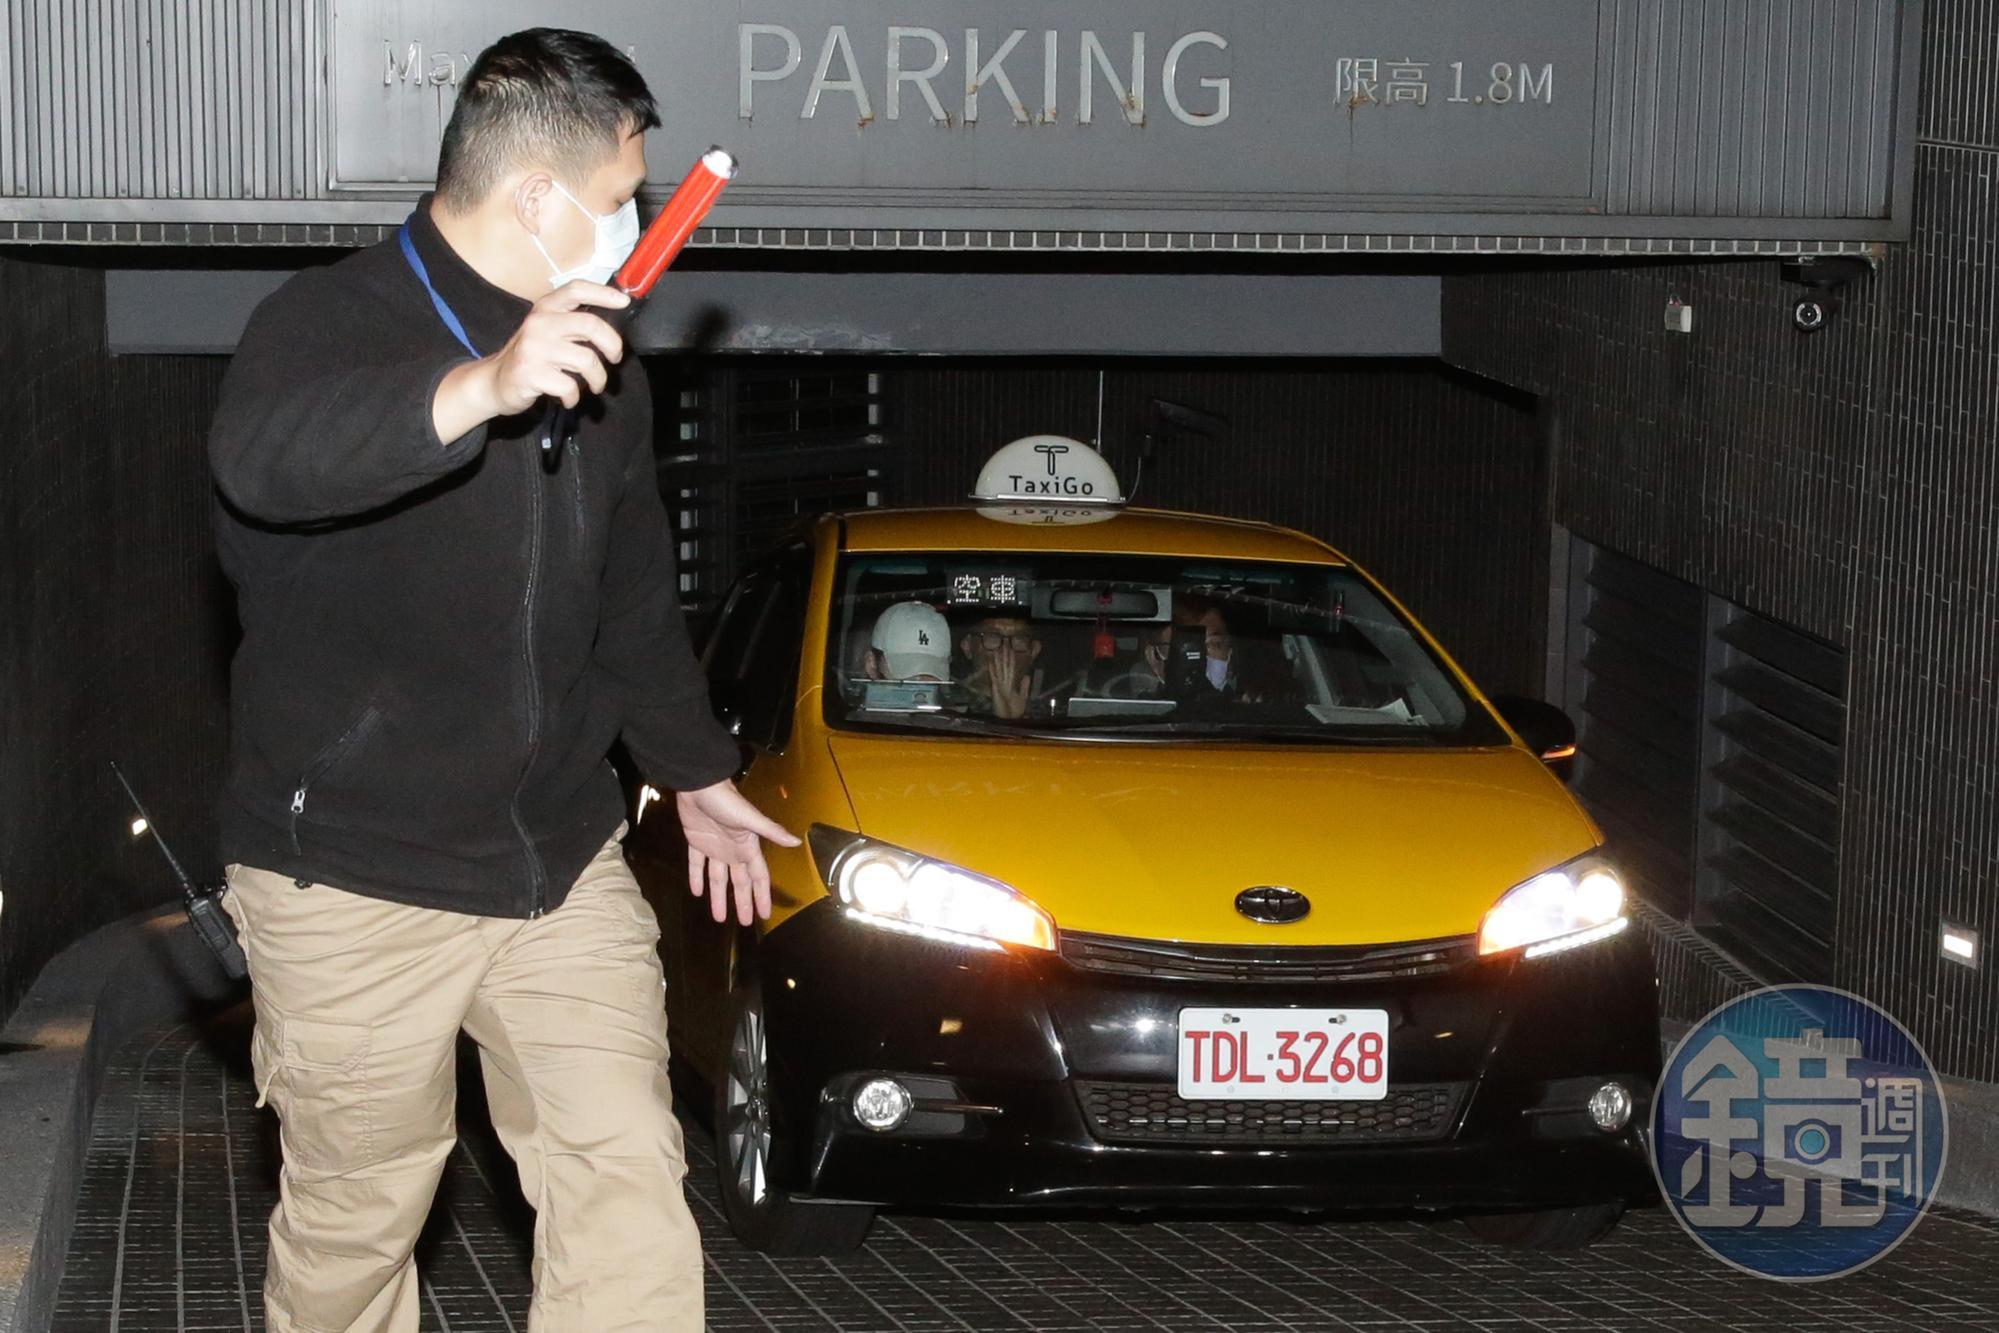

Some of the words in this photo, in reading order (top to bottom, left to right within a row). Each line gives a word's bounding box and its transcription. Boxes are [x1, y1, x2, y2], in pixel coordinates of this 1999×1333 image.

[738, 23, 1231, 127] PARKING
[1334, 57, 1430, 106] 限高
[1447, 61, 1554, 105] 1.8M
[1008, 474, 1094, 496] TaxiGo
[954, 574, 1016, 604] 空車
[918, 629, 930, 646] LA
